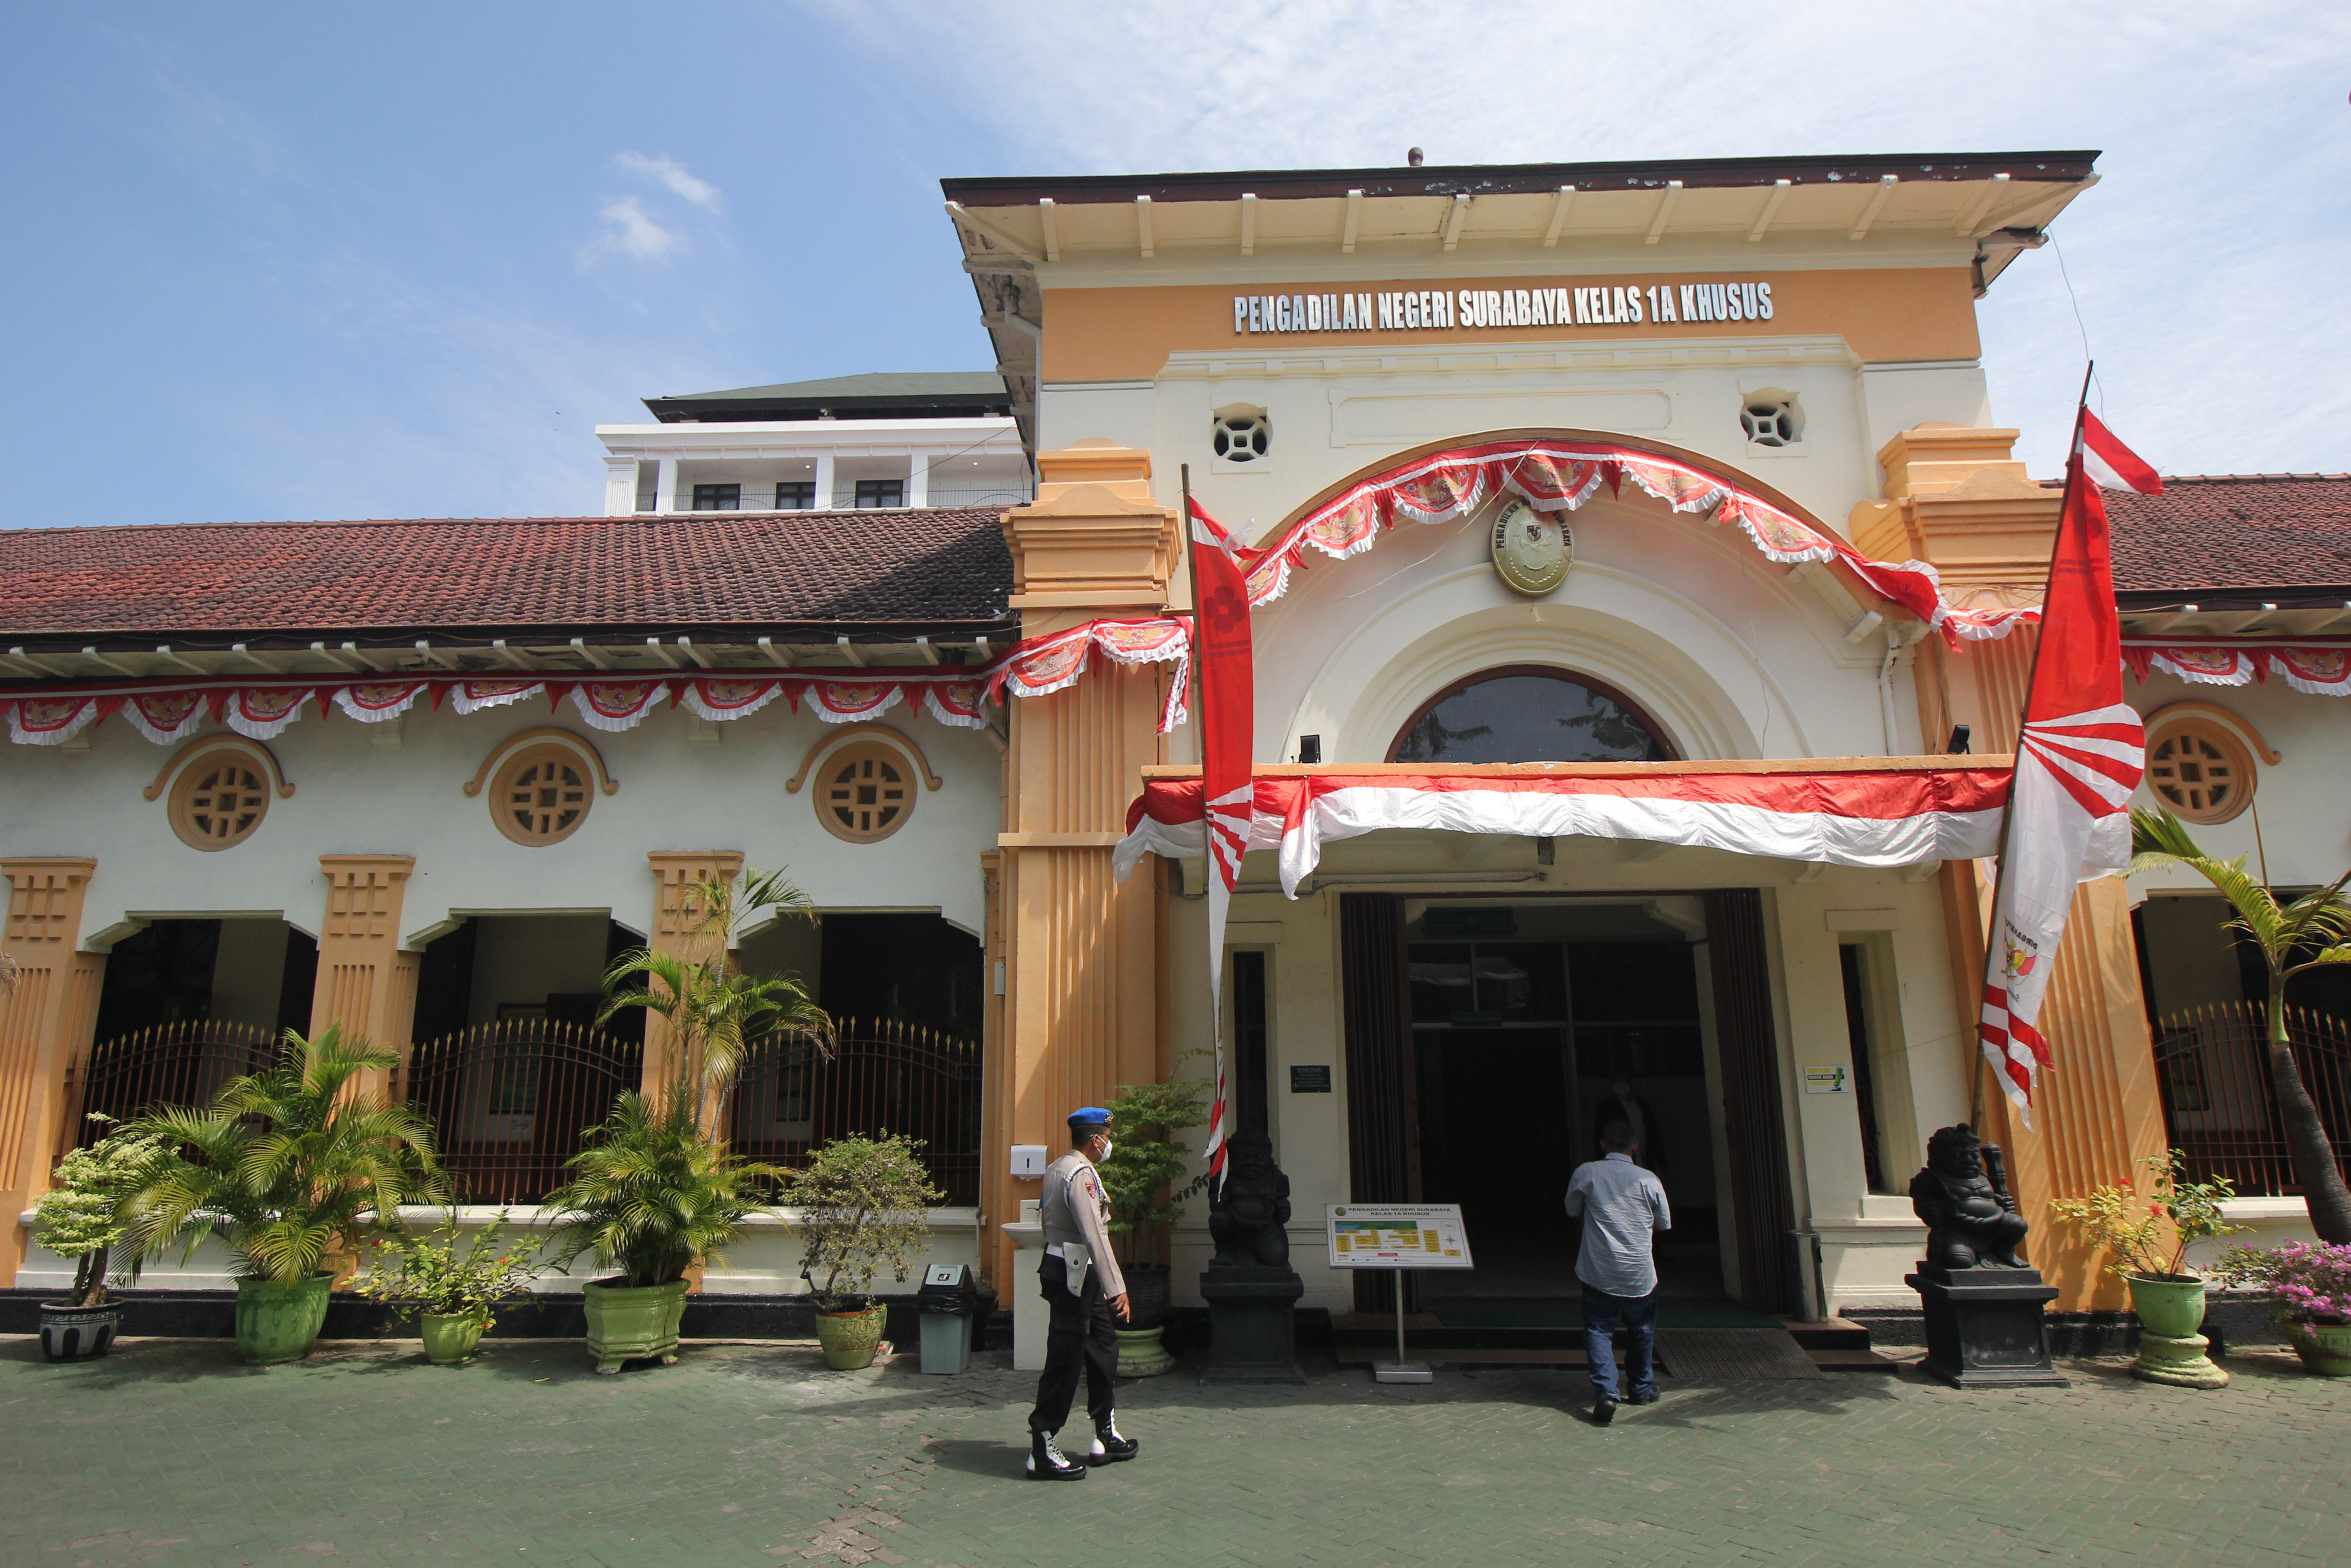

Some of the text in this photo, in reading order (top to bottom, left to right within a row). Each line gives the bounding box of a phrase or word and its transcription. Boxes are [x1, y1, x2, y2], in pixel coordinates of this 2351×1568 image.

[1234, 282, 1774, 333] PENGADILAN NEGERI SURABAYA KELAS 1A KHUSUS
[1496, 503, 1571, 549] PENGADILAN SURABAYA
